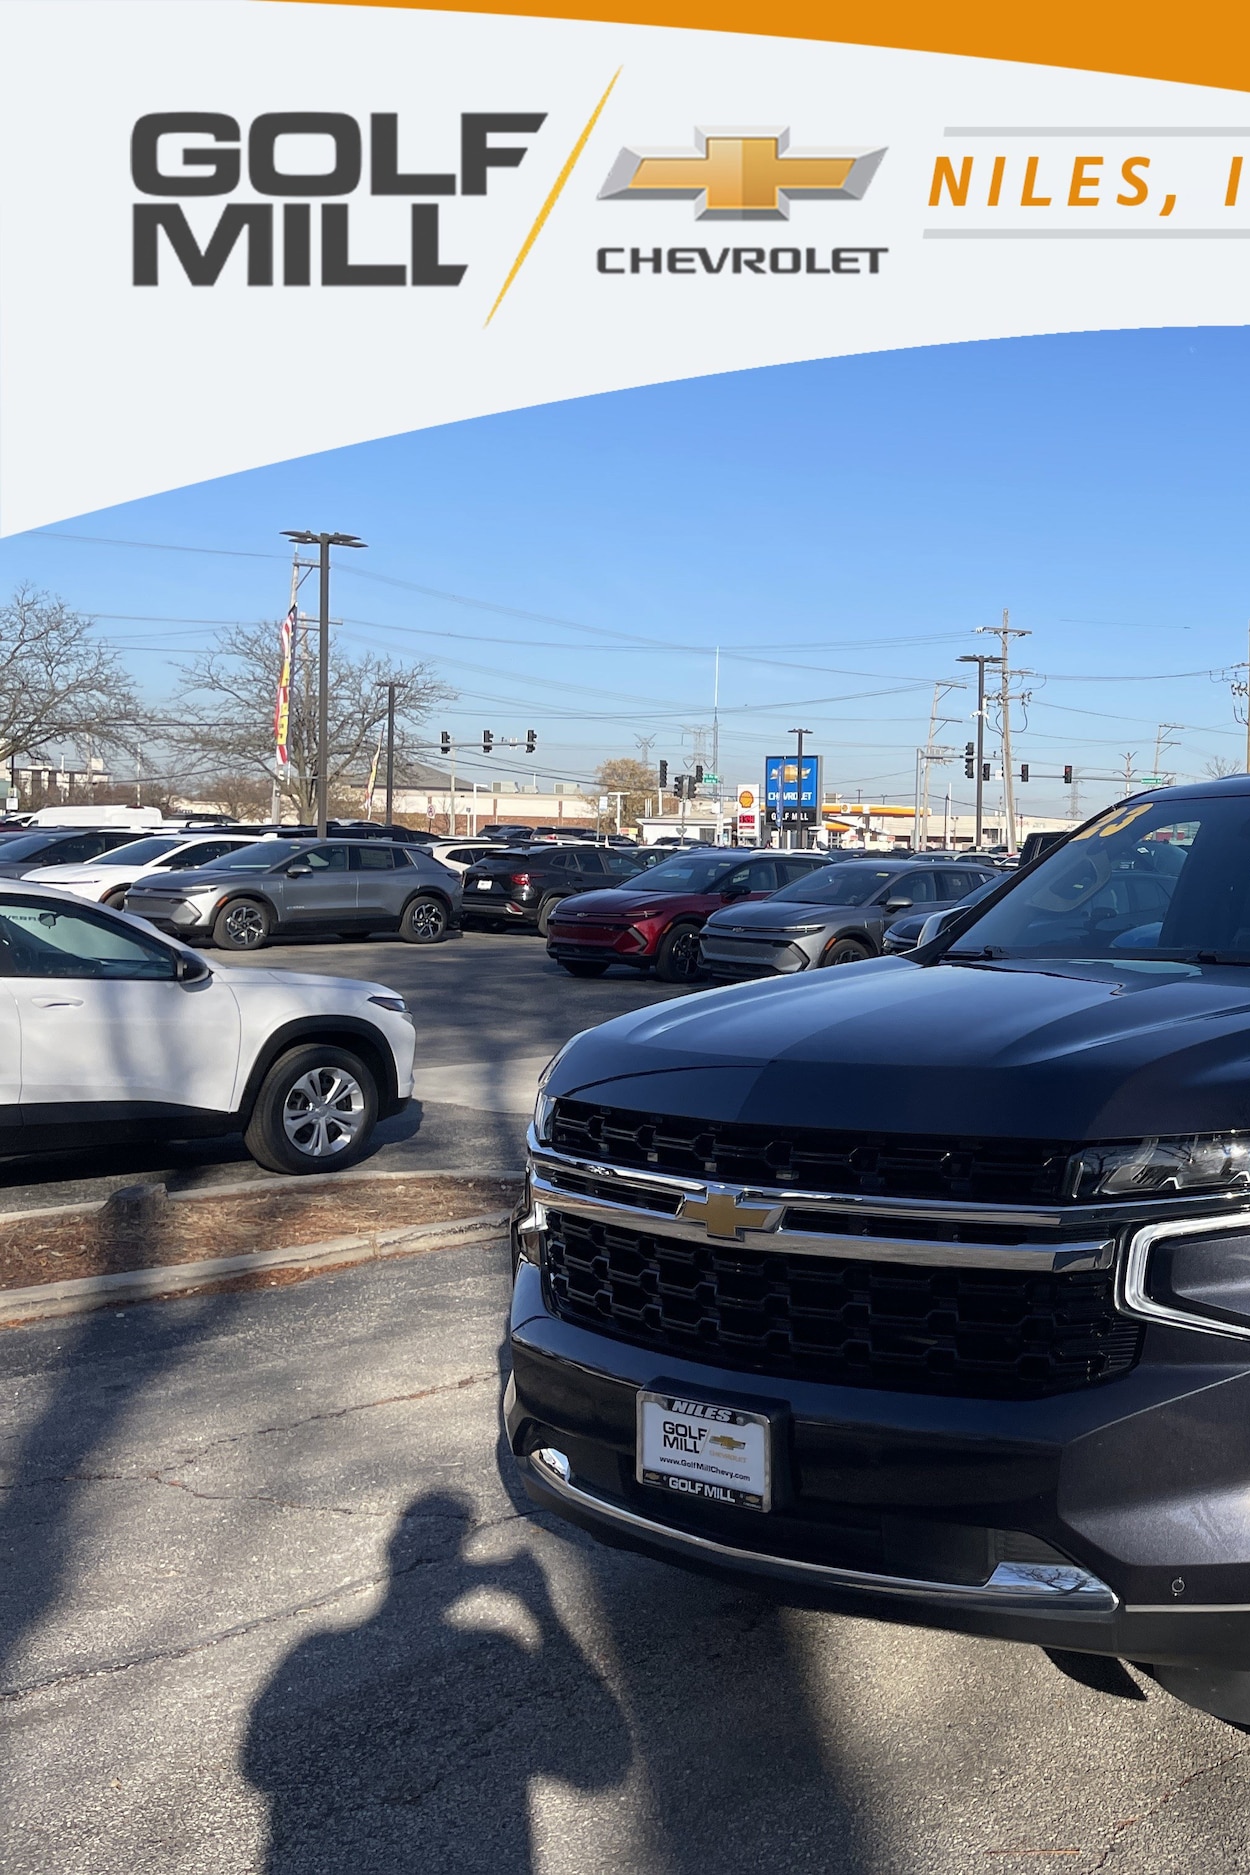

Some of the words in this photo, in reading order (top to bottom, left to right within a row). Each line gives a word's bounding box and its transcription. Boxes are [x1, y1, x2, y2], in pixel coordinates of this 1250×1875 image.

[768, 792, 812, 801] CHVROET
[771, 812, 789, 821] GF
[791, 812, 809, 821] MLL
[1069, 803, 1154, 843] 23
[672, 1400, 732, 1423] NILES
[662, 1421, 708, 1441] GOLF
[663, 1434, 700, 1454] MILL
[659, 1456, 751, 1482] www.GolfMillChevy.com
[668, 1476, 703, 1495] GOLF
[703, 1483, 736, 1503] MILL
